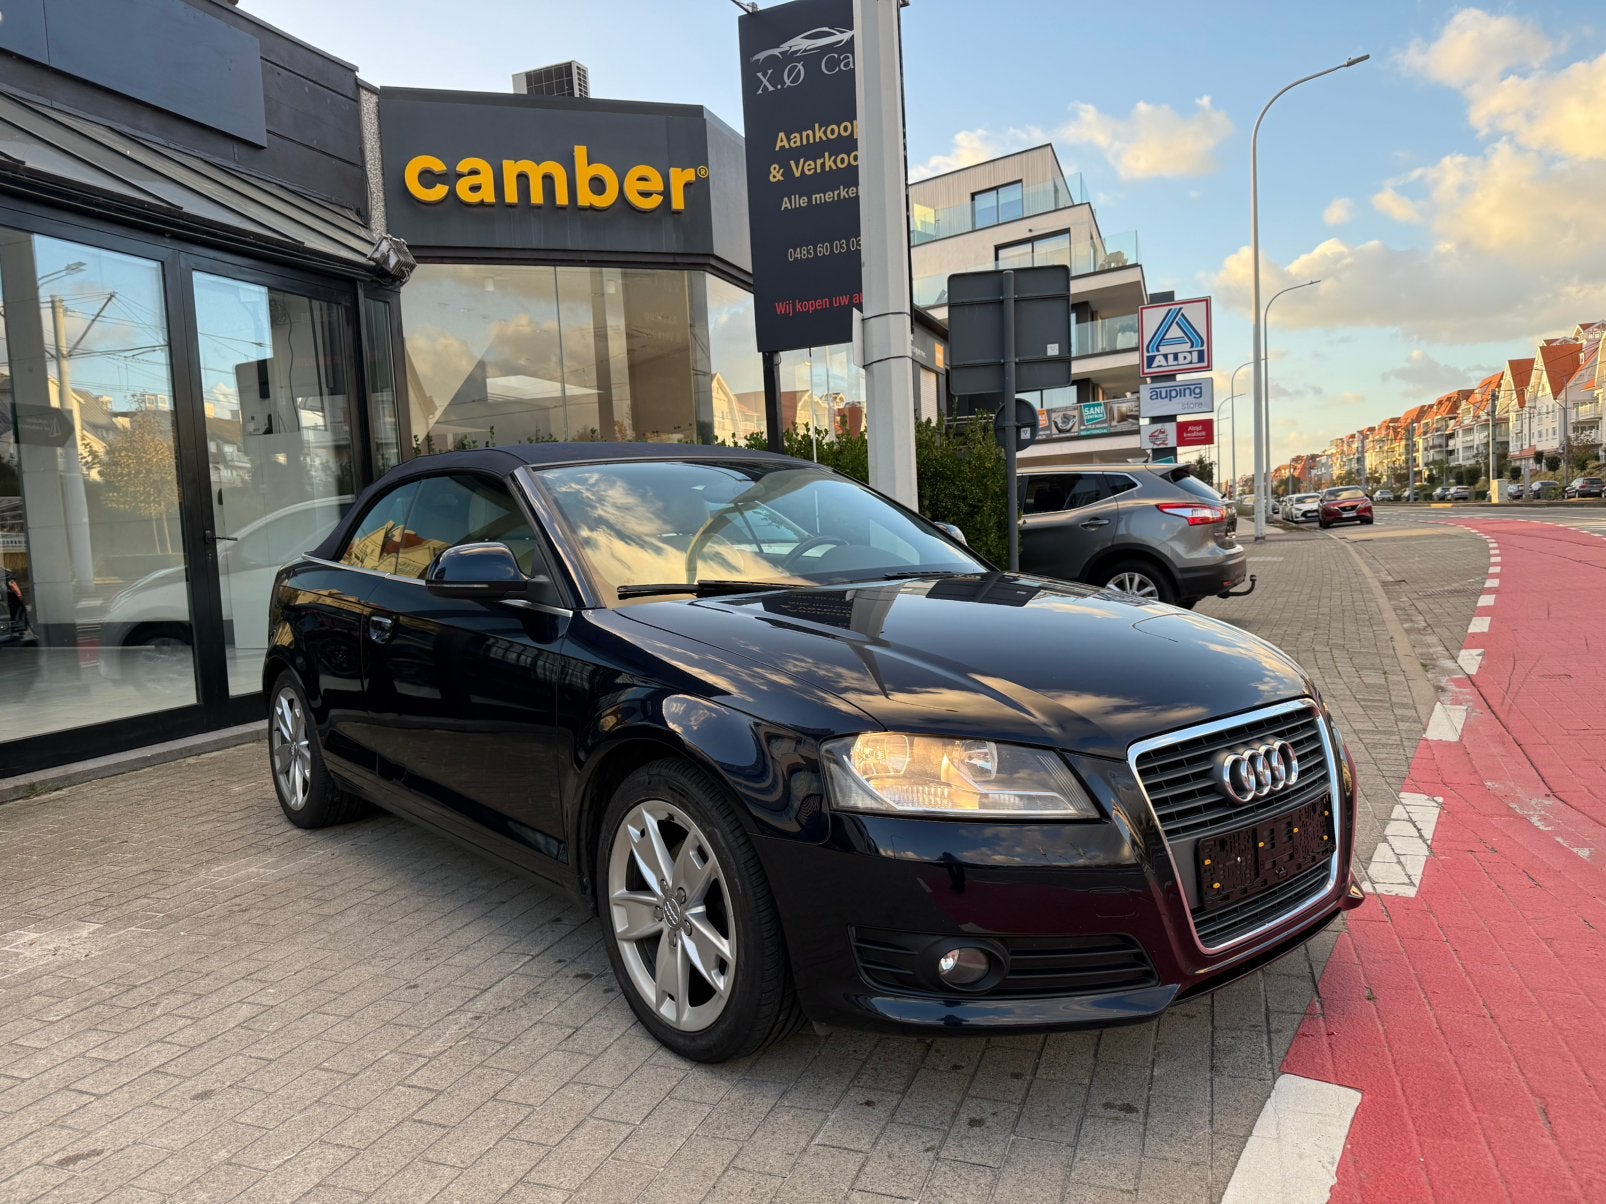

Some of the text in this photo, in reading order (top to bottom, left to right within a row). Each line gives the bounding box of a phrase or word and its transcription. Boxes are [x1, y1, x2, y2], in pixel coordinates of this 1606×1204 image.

[821, 53, 855, 75] Ca
[769, 152, 859, 183] & Verkoo
[781, 193, 808, 211] Alle
[787, 236, 862, 261] 0483 60 03 03
[775, 300, 793, 317] Wij
[796, 297, 830, 314] kopen
[832, 295, 850, 307] uw
[1151, 350, 1199, 368] ALDI
[1149, 384, 1203, 402] auping
[1084, 406, 1104, 415] SANI
[1181, 401, 1203, 410] store
